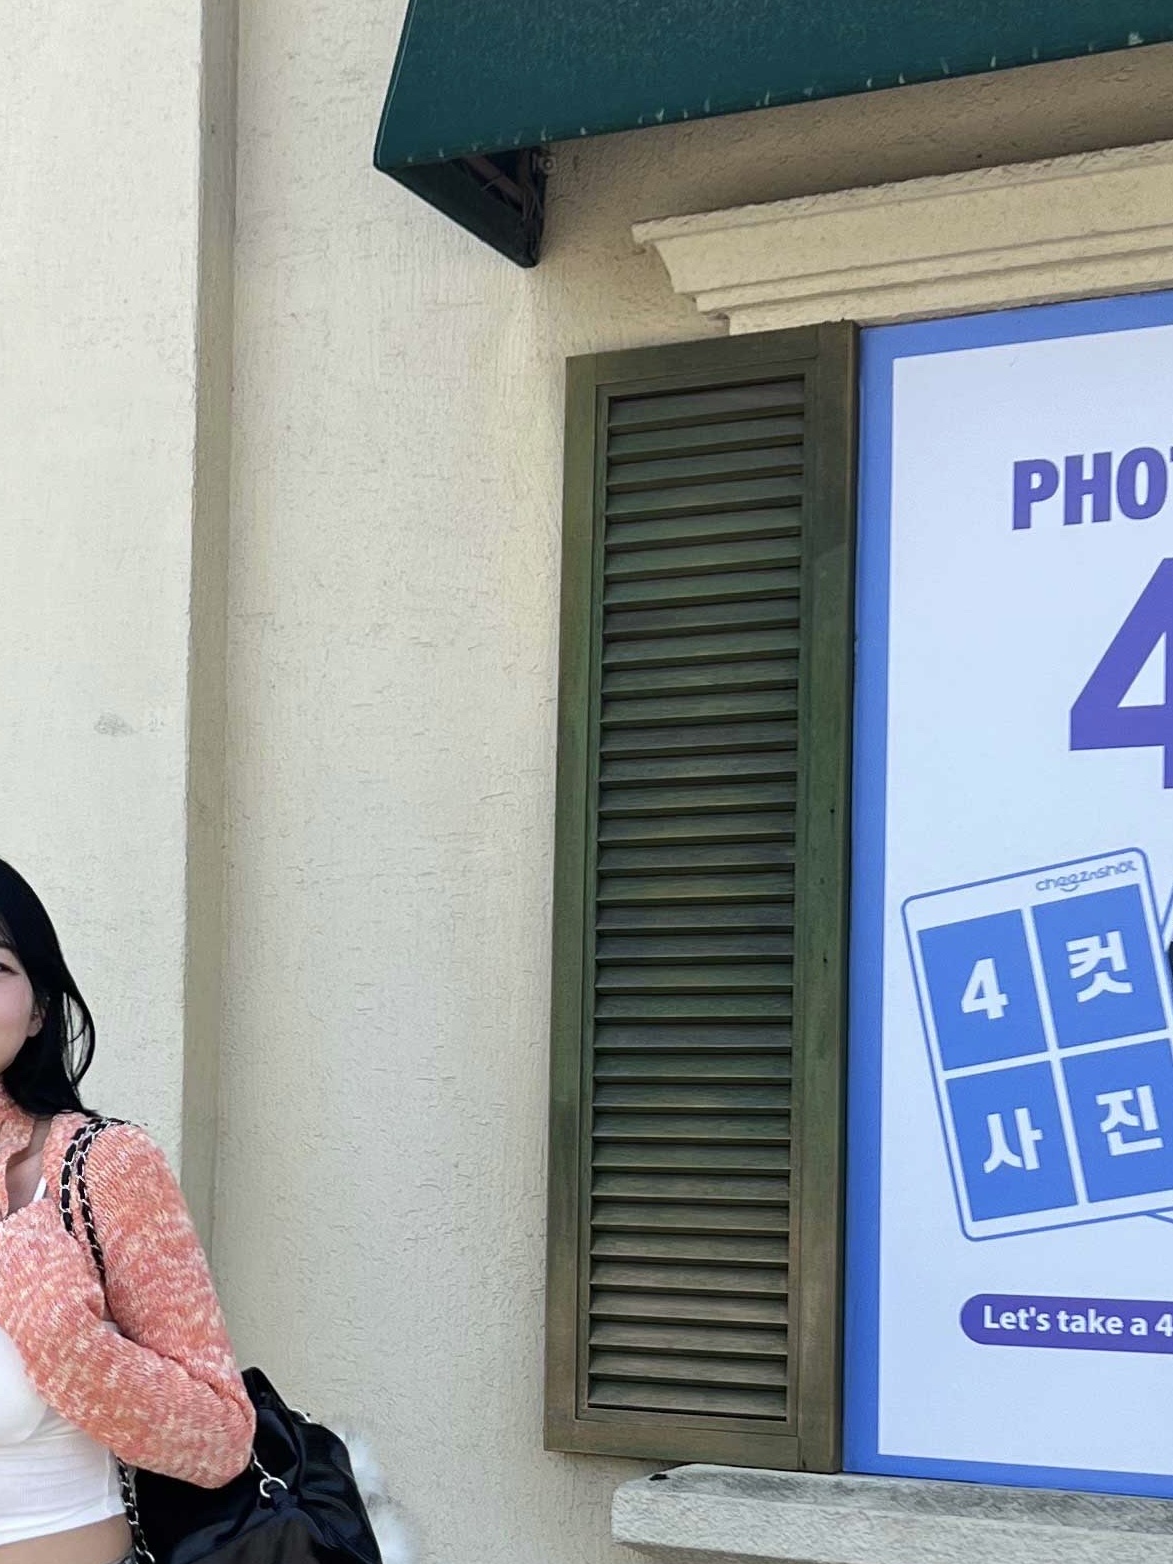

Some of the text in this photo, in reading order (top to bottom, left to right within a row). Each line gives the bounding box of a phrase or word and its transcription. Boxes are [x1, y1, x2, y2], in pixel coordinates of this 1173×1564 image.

[1012, 446, 1173, 530] PHO
[983, 1305, 1051, 1331] Let's
[1056, 1308, 1124, 1335] take
[1130, 1317, 1148, 1336] a
